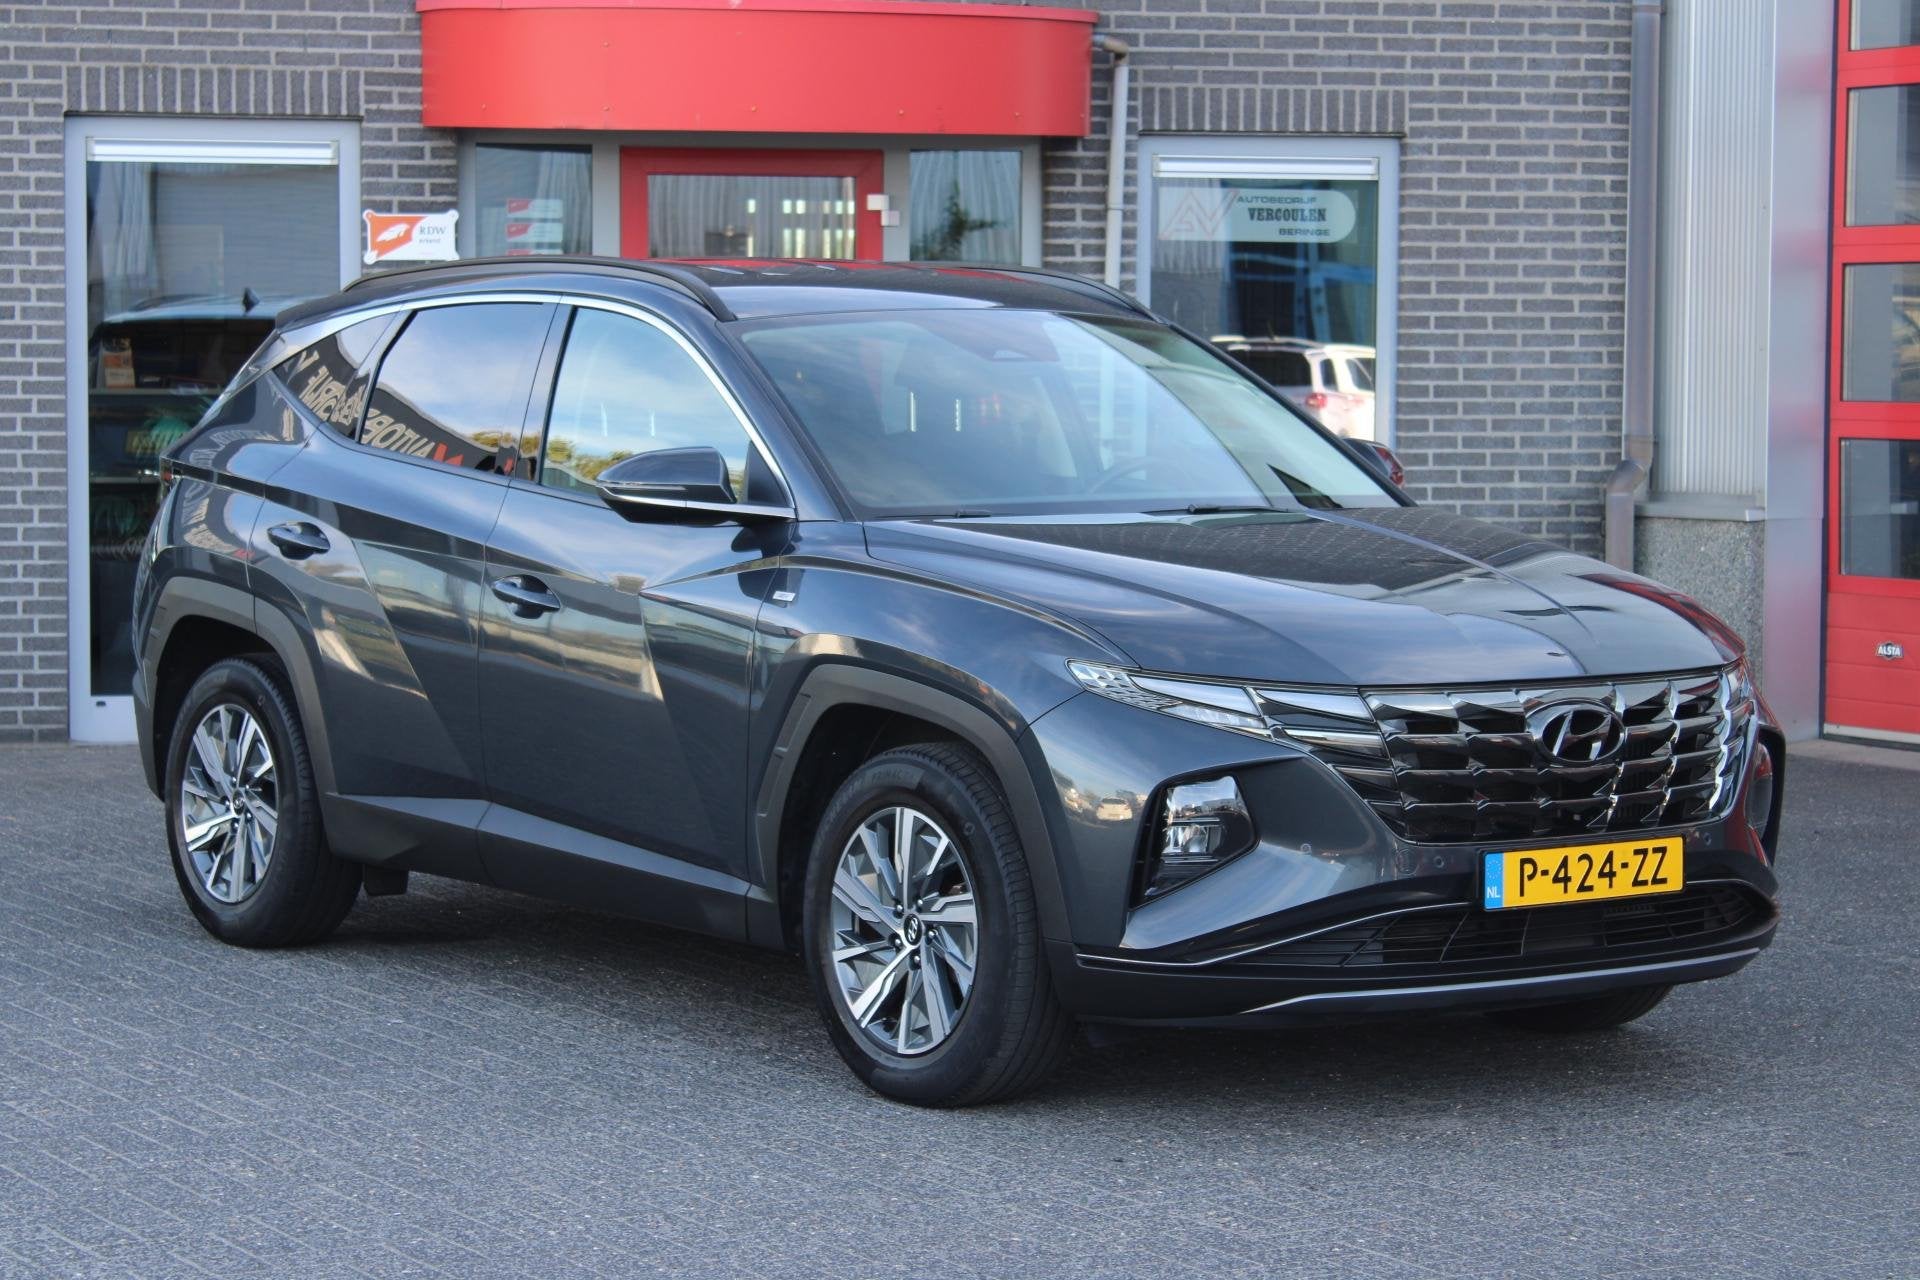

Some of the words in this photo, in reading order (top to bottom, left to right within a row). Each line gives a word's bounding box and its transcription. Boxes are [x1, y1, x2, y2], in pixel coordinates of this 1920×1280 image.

[1237, 196, 1317, 204] AUTOBEDRIJF
[1248, 207, 1327, 221] VERCOULEN
[419, 225, 446, 235] RDW
[1279, 228, 1330, 236] BERINGE
[1877, 645, 1902, 656] ALSTA
[1519, 846, 1667, 897] P-424-ZZ
[1486, 886, 1500, 898] NL
